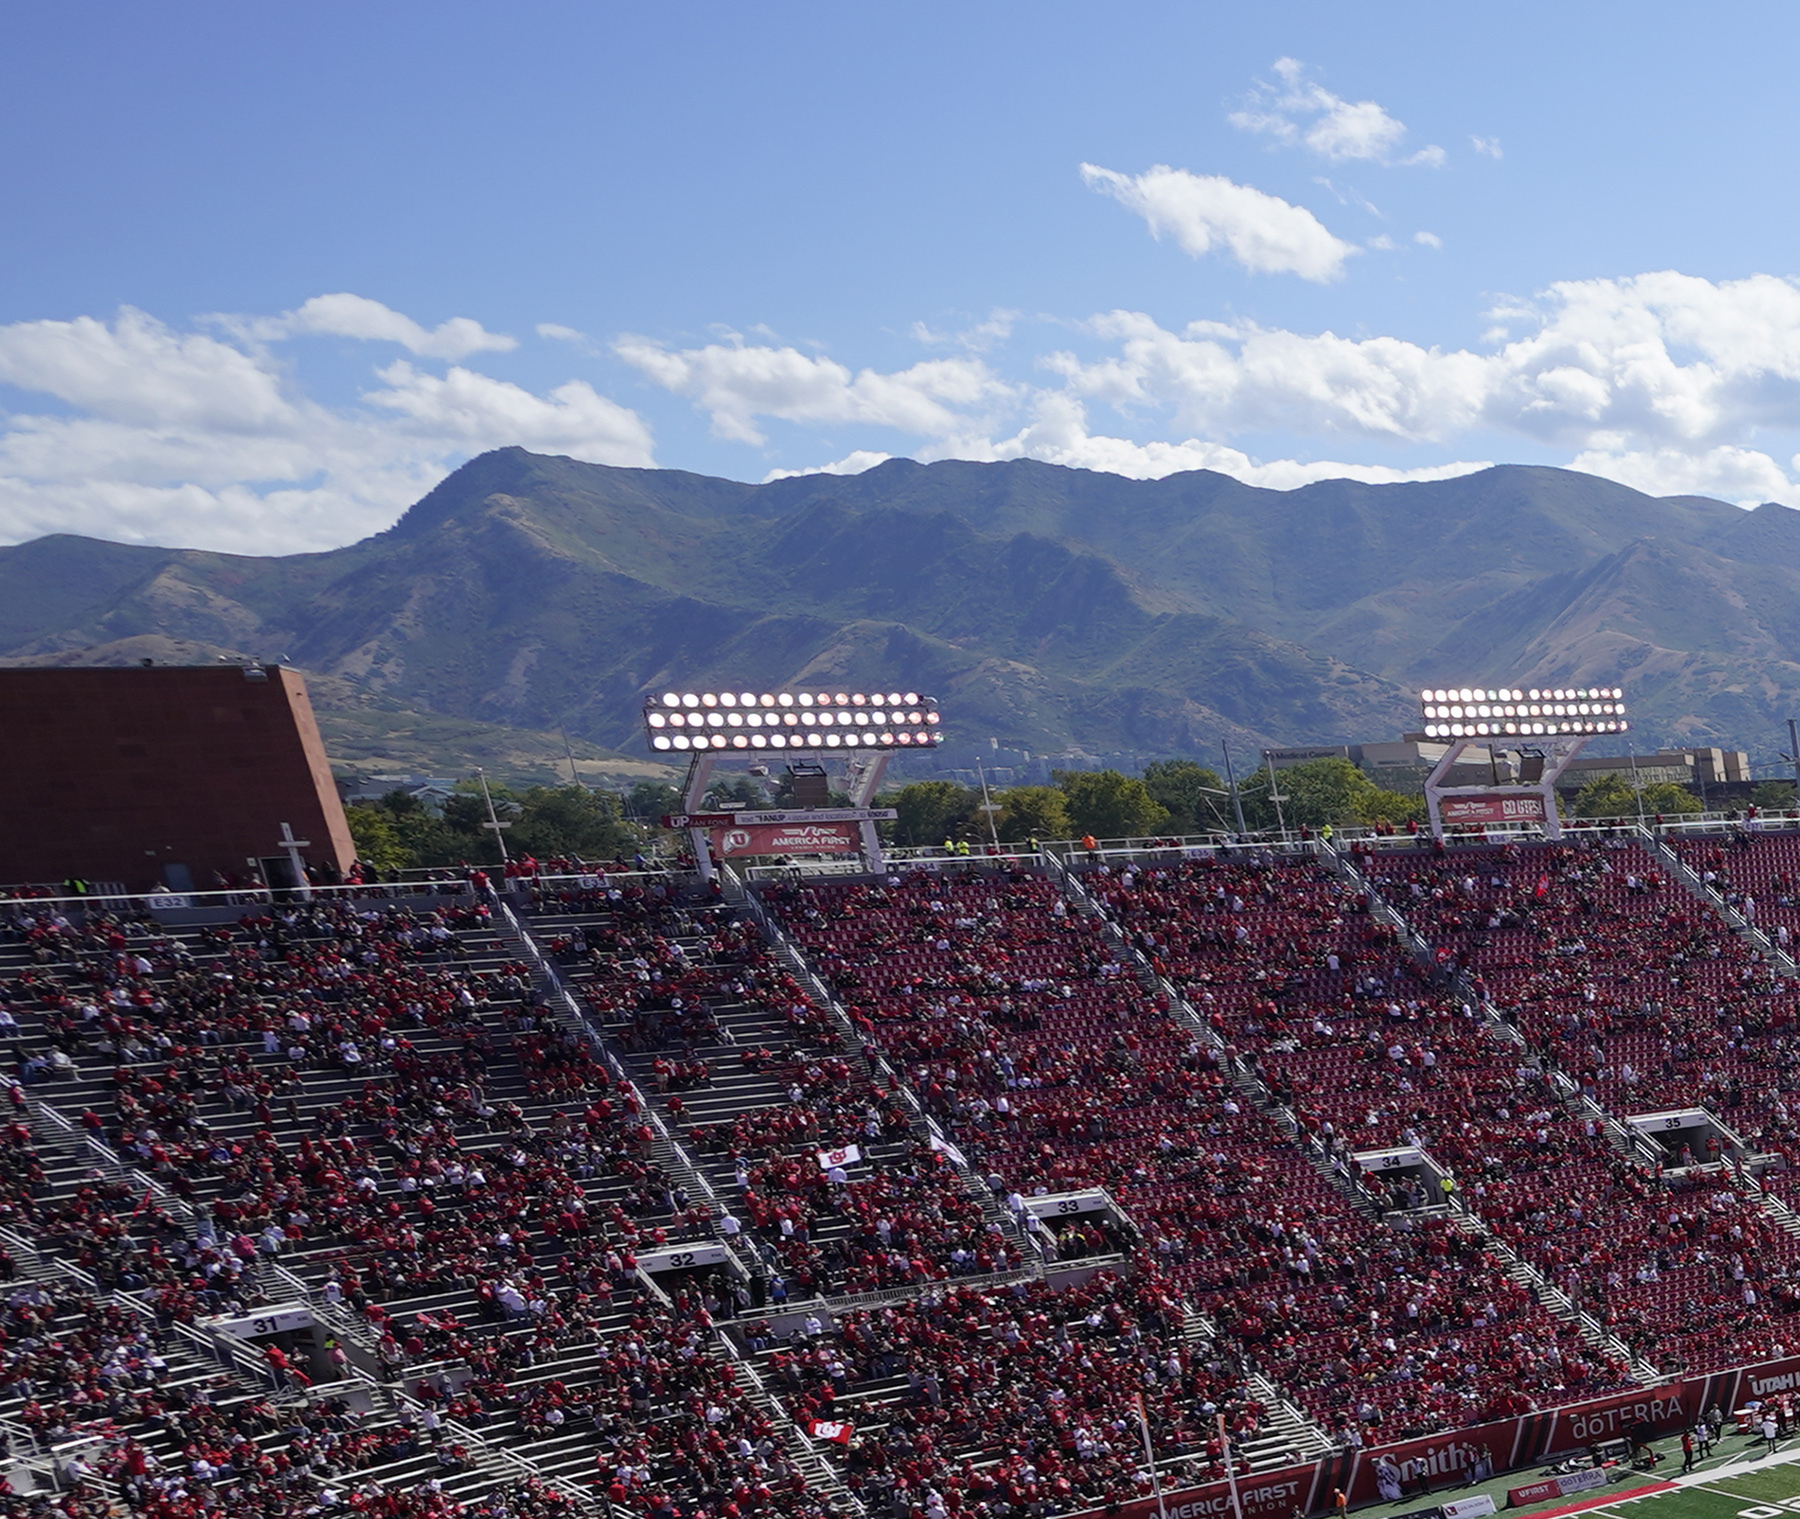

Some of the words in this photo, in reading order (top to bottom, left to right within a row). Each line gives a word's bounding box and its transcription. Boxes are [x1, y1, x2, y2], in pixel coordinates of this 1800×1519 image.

[1502, 800, 1516, 814] GO
[670, 817, 689, 827] UP
[772, 837, 820, 846] AMERICA
[820, 837, 850, 845] FIRST
[155, 898, 182, 907] E32
[1666, 1118, 1681, 1128] 35
[1382, 1156, 1400, 1168] 34
[1058, 1200, 1079, 1213] 33
[670, 1252, 696, 1268] 32
[252, 1316, 278, 1334] 31
[1752, 1373, 1794, 1396] UTAH
[1242, 1481, 1299, 1507] FIRST
[1518, 1485, 1550, 1499] UFIRST
